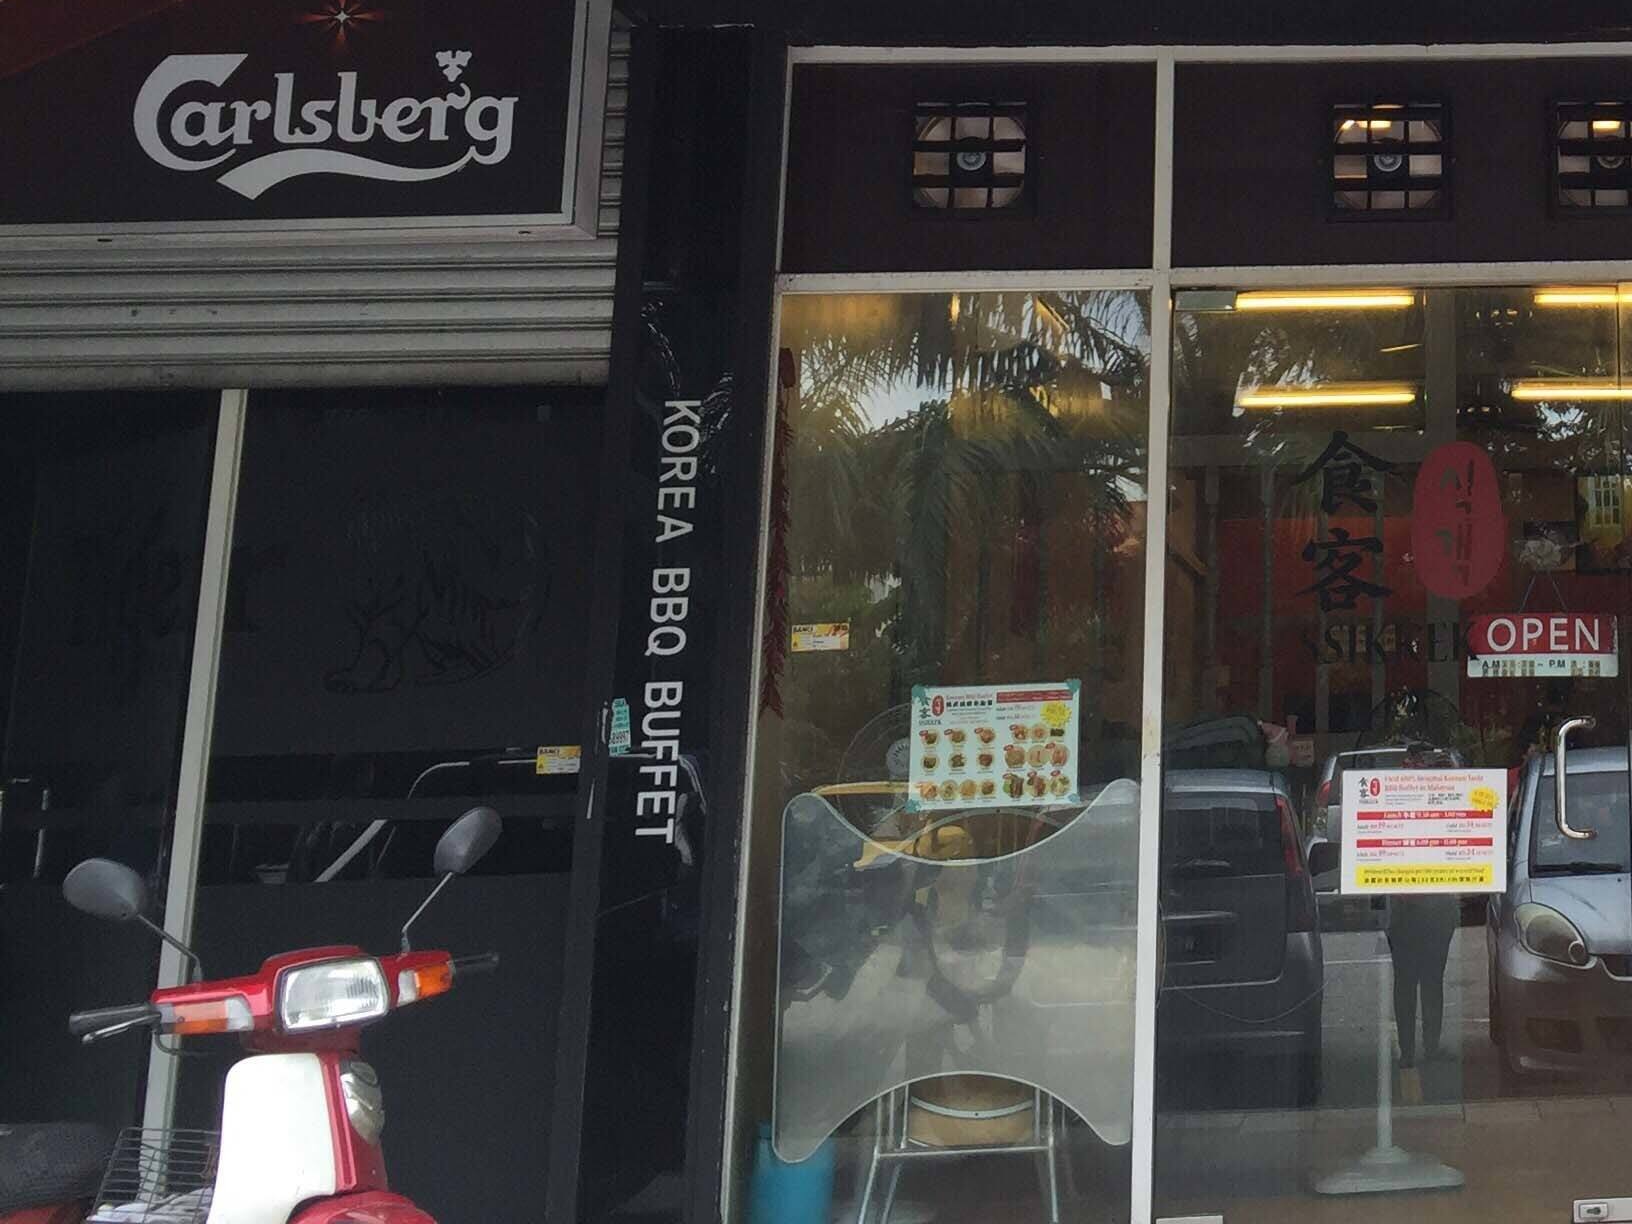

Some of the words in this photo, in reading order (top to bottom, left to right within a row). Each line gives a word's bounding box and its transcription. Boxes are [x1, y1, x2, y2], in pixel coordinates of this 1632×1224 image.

[134, 53, 519, 200] Carlsberg
[655, 399, 701, 544] KOREA
[644, 567, 691, 657] BBQ
[1486, 617, 1600, 653] OPEN
[635, 681, 683, 845] BUFFET
